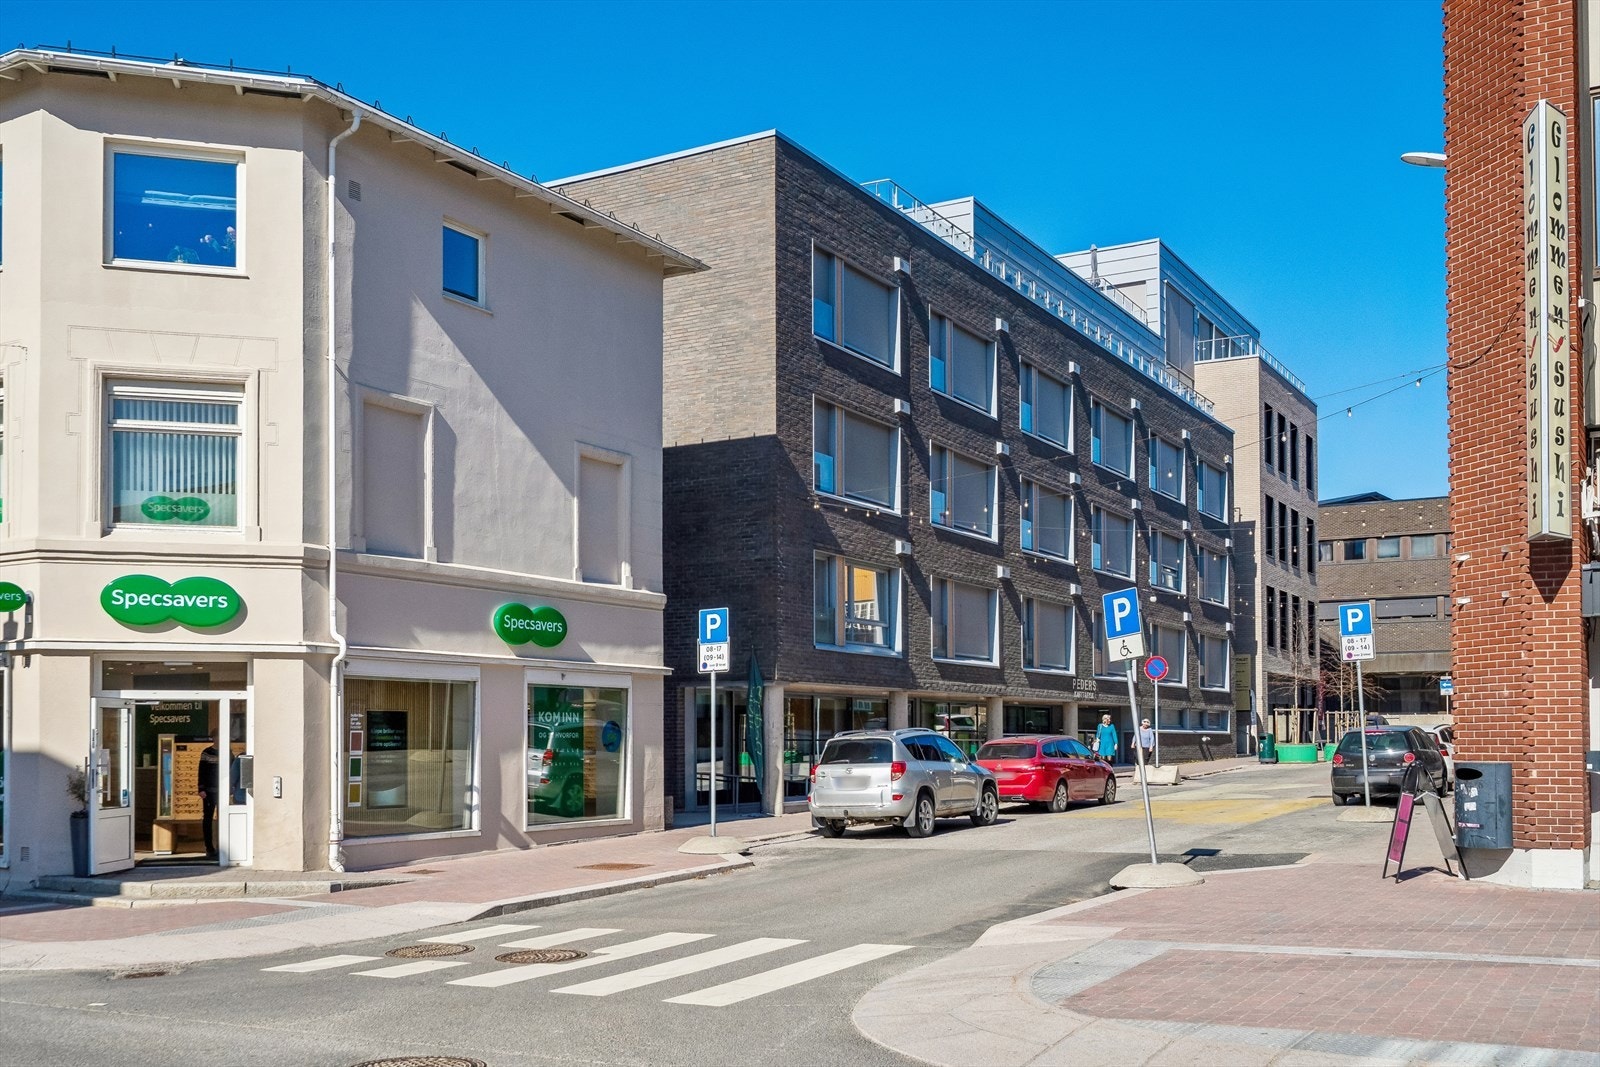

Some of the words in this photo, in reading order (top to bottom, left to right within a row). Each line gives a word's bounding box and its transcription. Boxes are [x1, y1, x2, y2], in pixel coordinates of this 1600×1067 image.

[1526, 122, 1540, 331] Glommen
[1550, 119, 1567, 330] Glommen
[147, 501, 204, 514] Specsavers
[111, 588, 229, 610] Specsavers
[503, 613, 564, 635] Specsavers
[1112, 596, 1131, 632] P
[1347, 608, 1364, 632] P
[706, 613, 722, 640] P
[1072, 678, 1097, 691] PEDERS
[149, 714, 191, 725] Specsavers
[562, 712, 580, 723] INN
